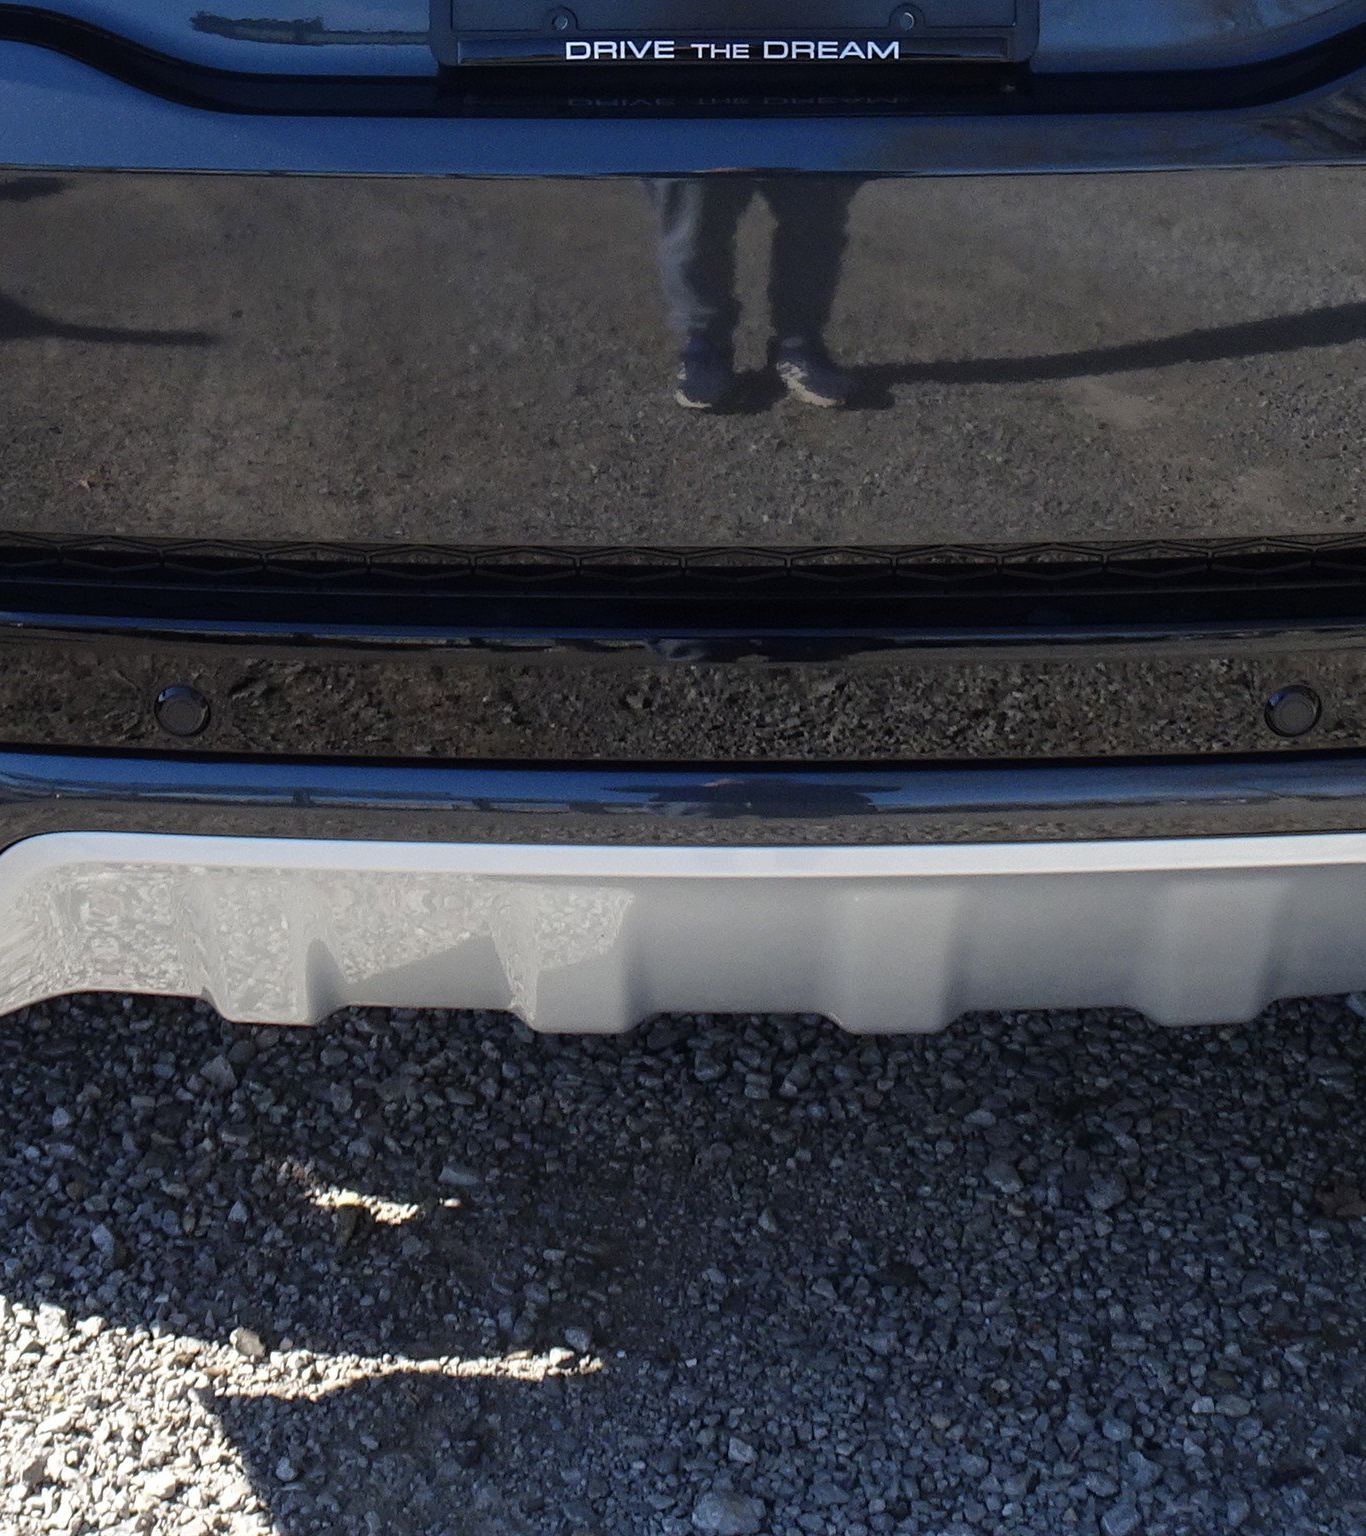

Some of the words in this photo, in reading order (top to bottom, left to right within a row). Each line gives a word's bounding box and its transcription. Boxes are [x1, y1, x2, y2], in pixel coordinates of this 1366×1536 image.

[565, 40, 676, 60] DRIVE
[690, 44, 750, 60] THE
[763, 40, 900, 60] DREAM
